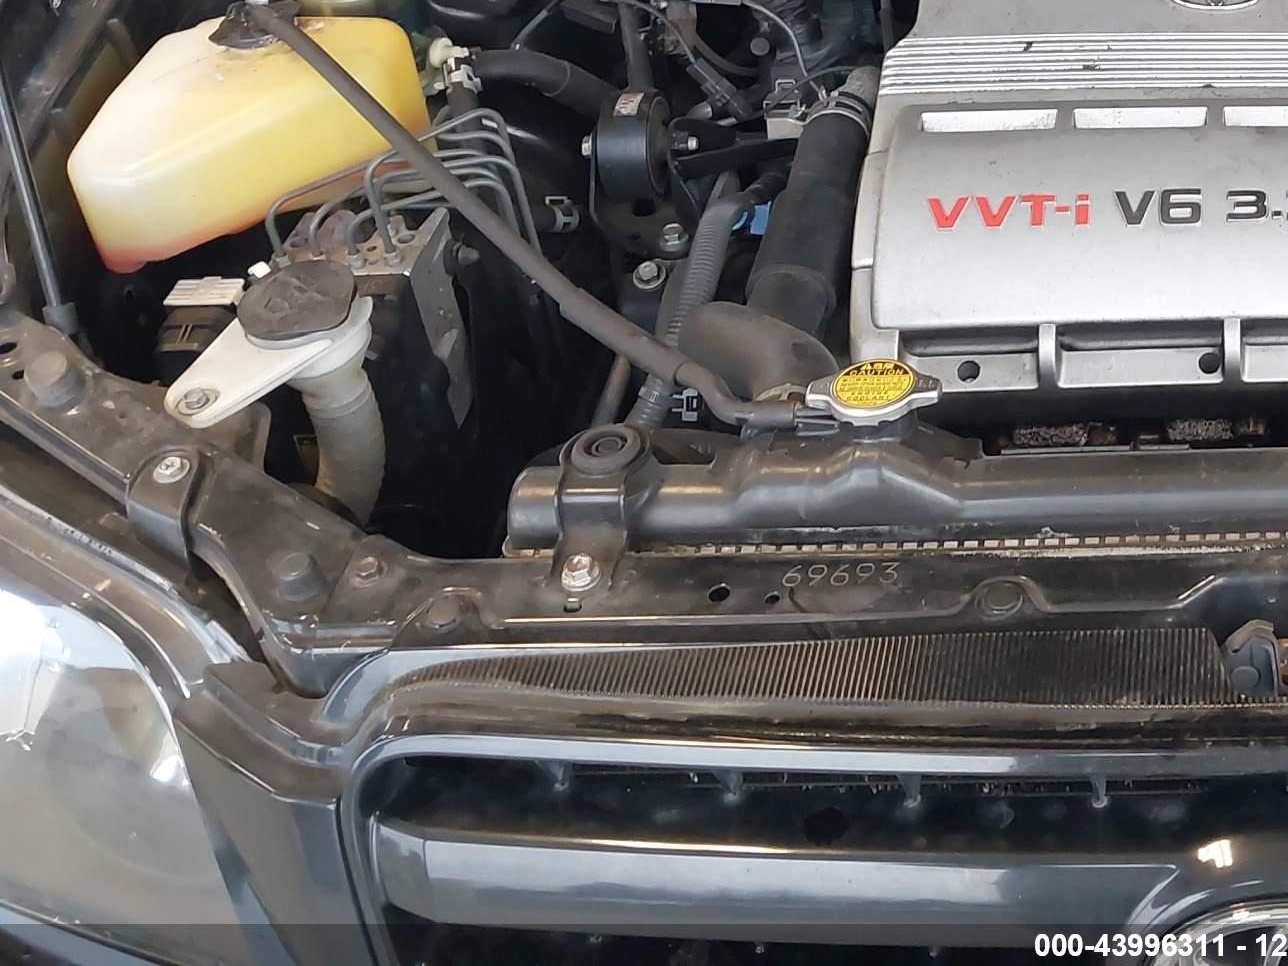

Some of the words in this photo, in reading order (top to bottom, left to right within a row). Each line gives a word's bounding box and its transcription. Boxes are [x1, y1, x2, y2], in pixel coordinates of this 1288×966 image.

[928, 194, 1091, 230] VVT-i
[1114, 188, 1202, 227] V6
[782, 561, 901, 587] 69693
